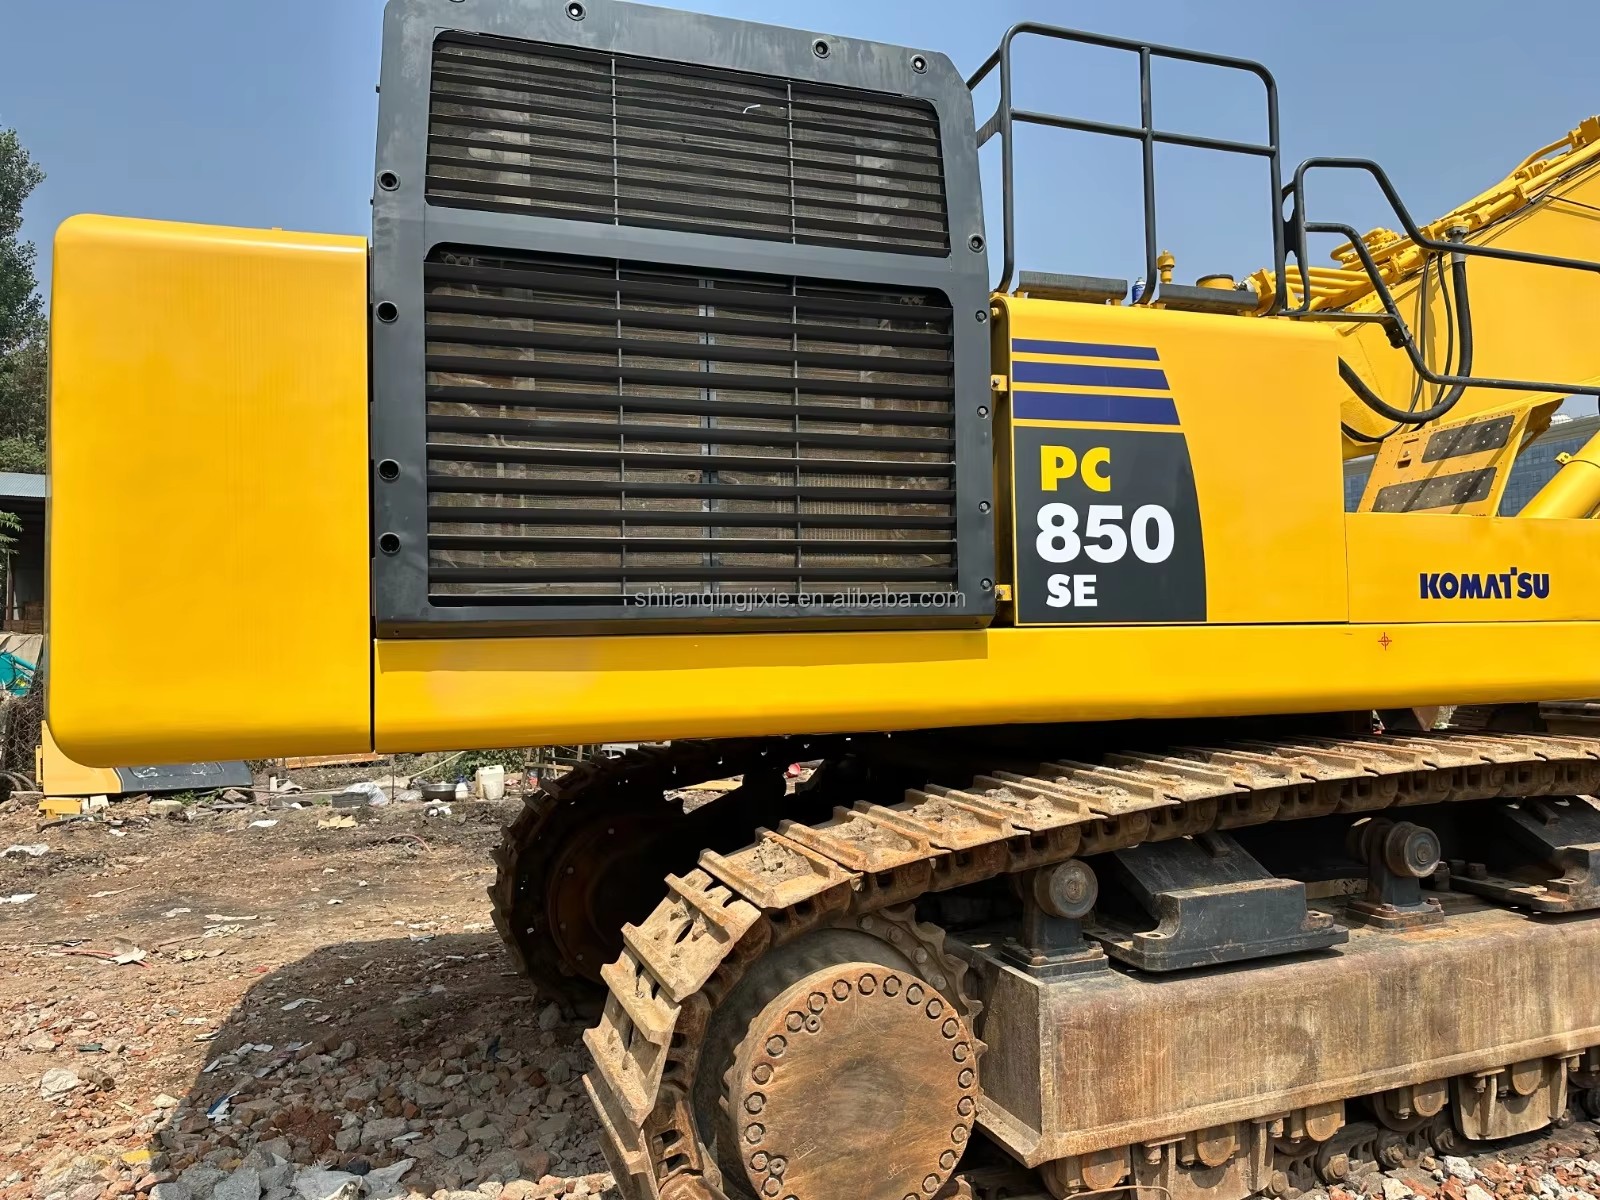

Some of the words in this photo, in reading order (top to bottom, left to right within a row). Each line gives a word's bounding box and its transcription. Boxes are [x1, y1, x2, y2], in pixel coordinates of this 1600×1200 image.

[1040, 445, 1111, 492] PC
[1035, 502, 1175, 564] 850
[1045, 573, 1098, 608] SE
[1420, 566, 1549, 599] KOMATSU
